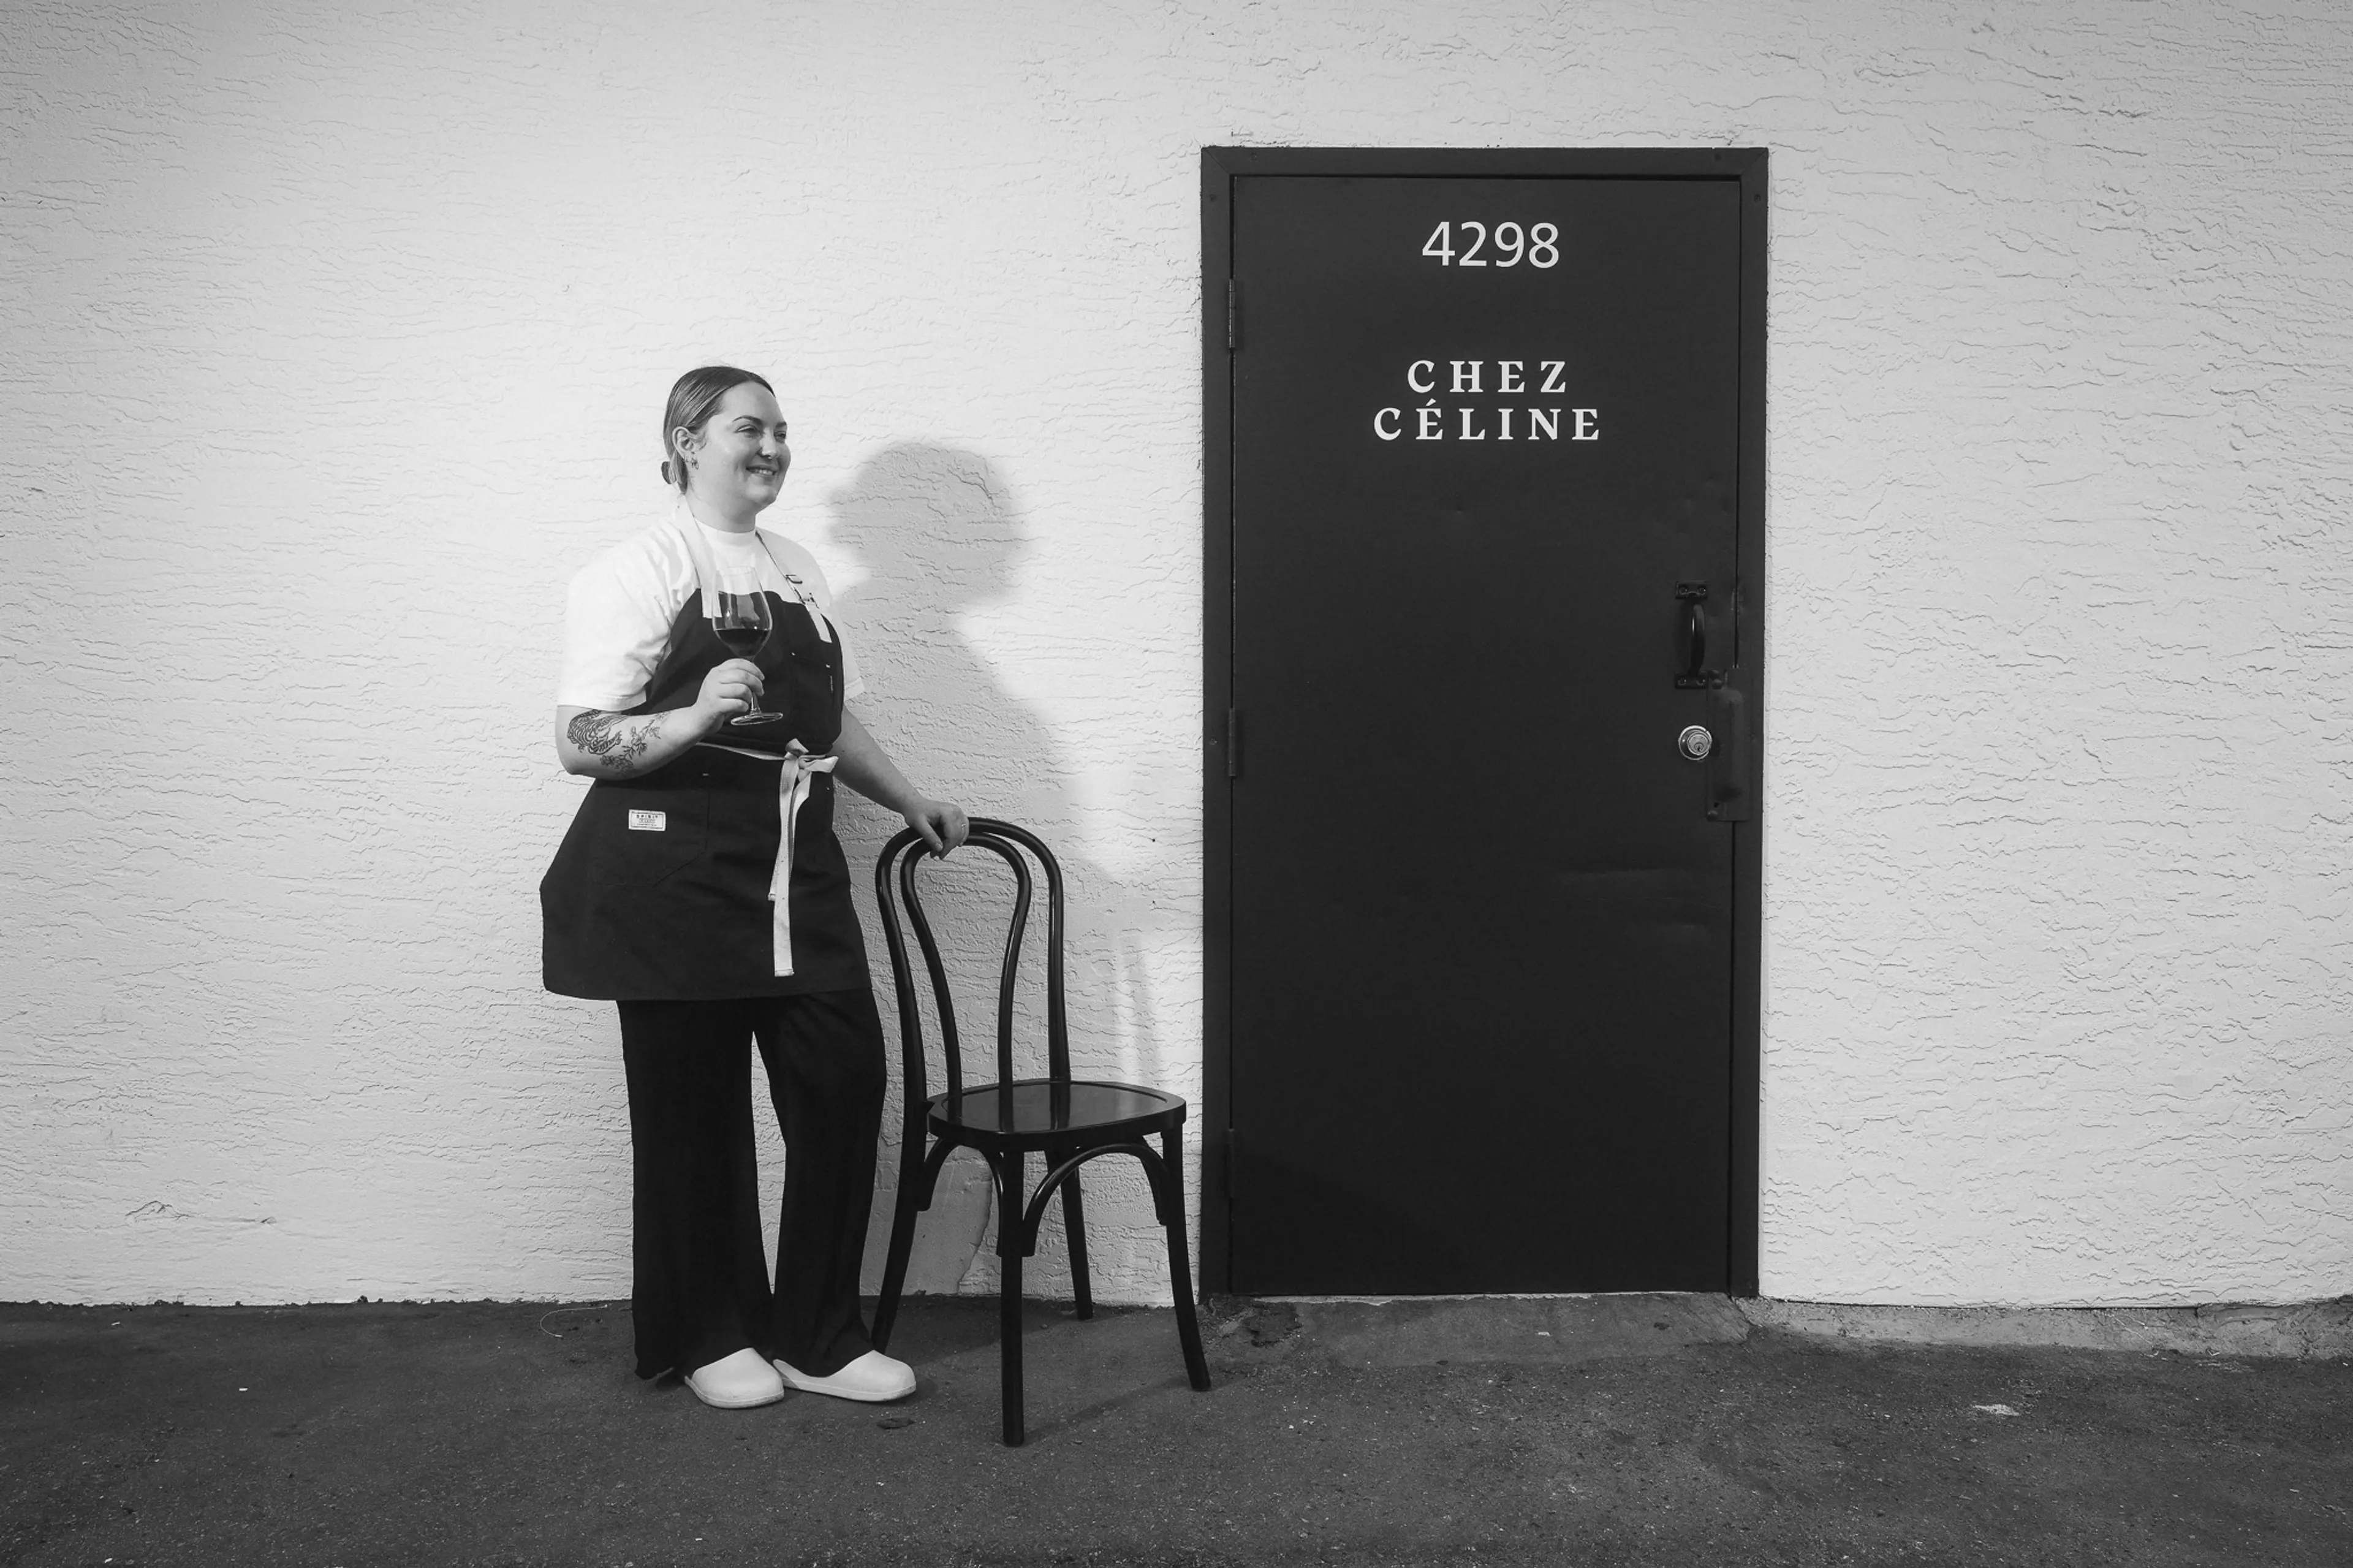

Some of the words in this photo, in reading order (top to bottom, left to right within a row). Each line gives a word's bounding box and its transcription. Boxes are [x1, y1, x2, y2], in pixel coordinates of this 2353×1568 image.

[1422, 221, 1559, 268] 4298
[1407, 359, 1566, 393] CHEZ
[1374, 398, 1599, 441] CÉLINE
